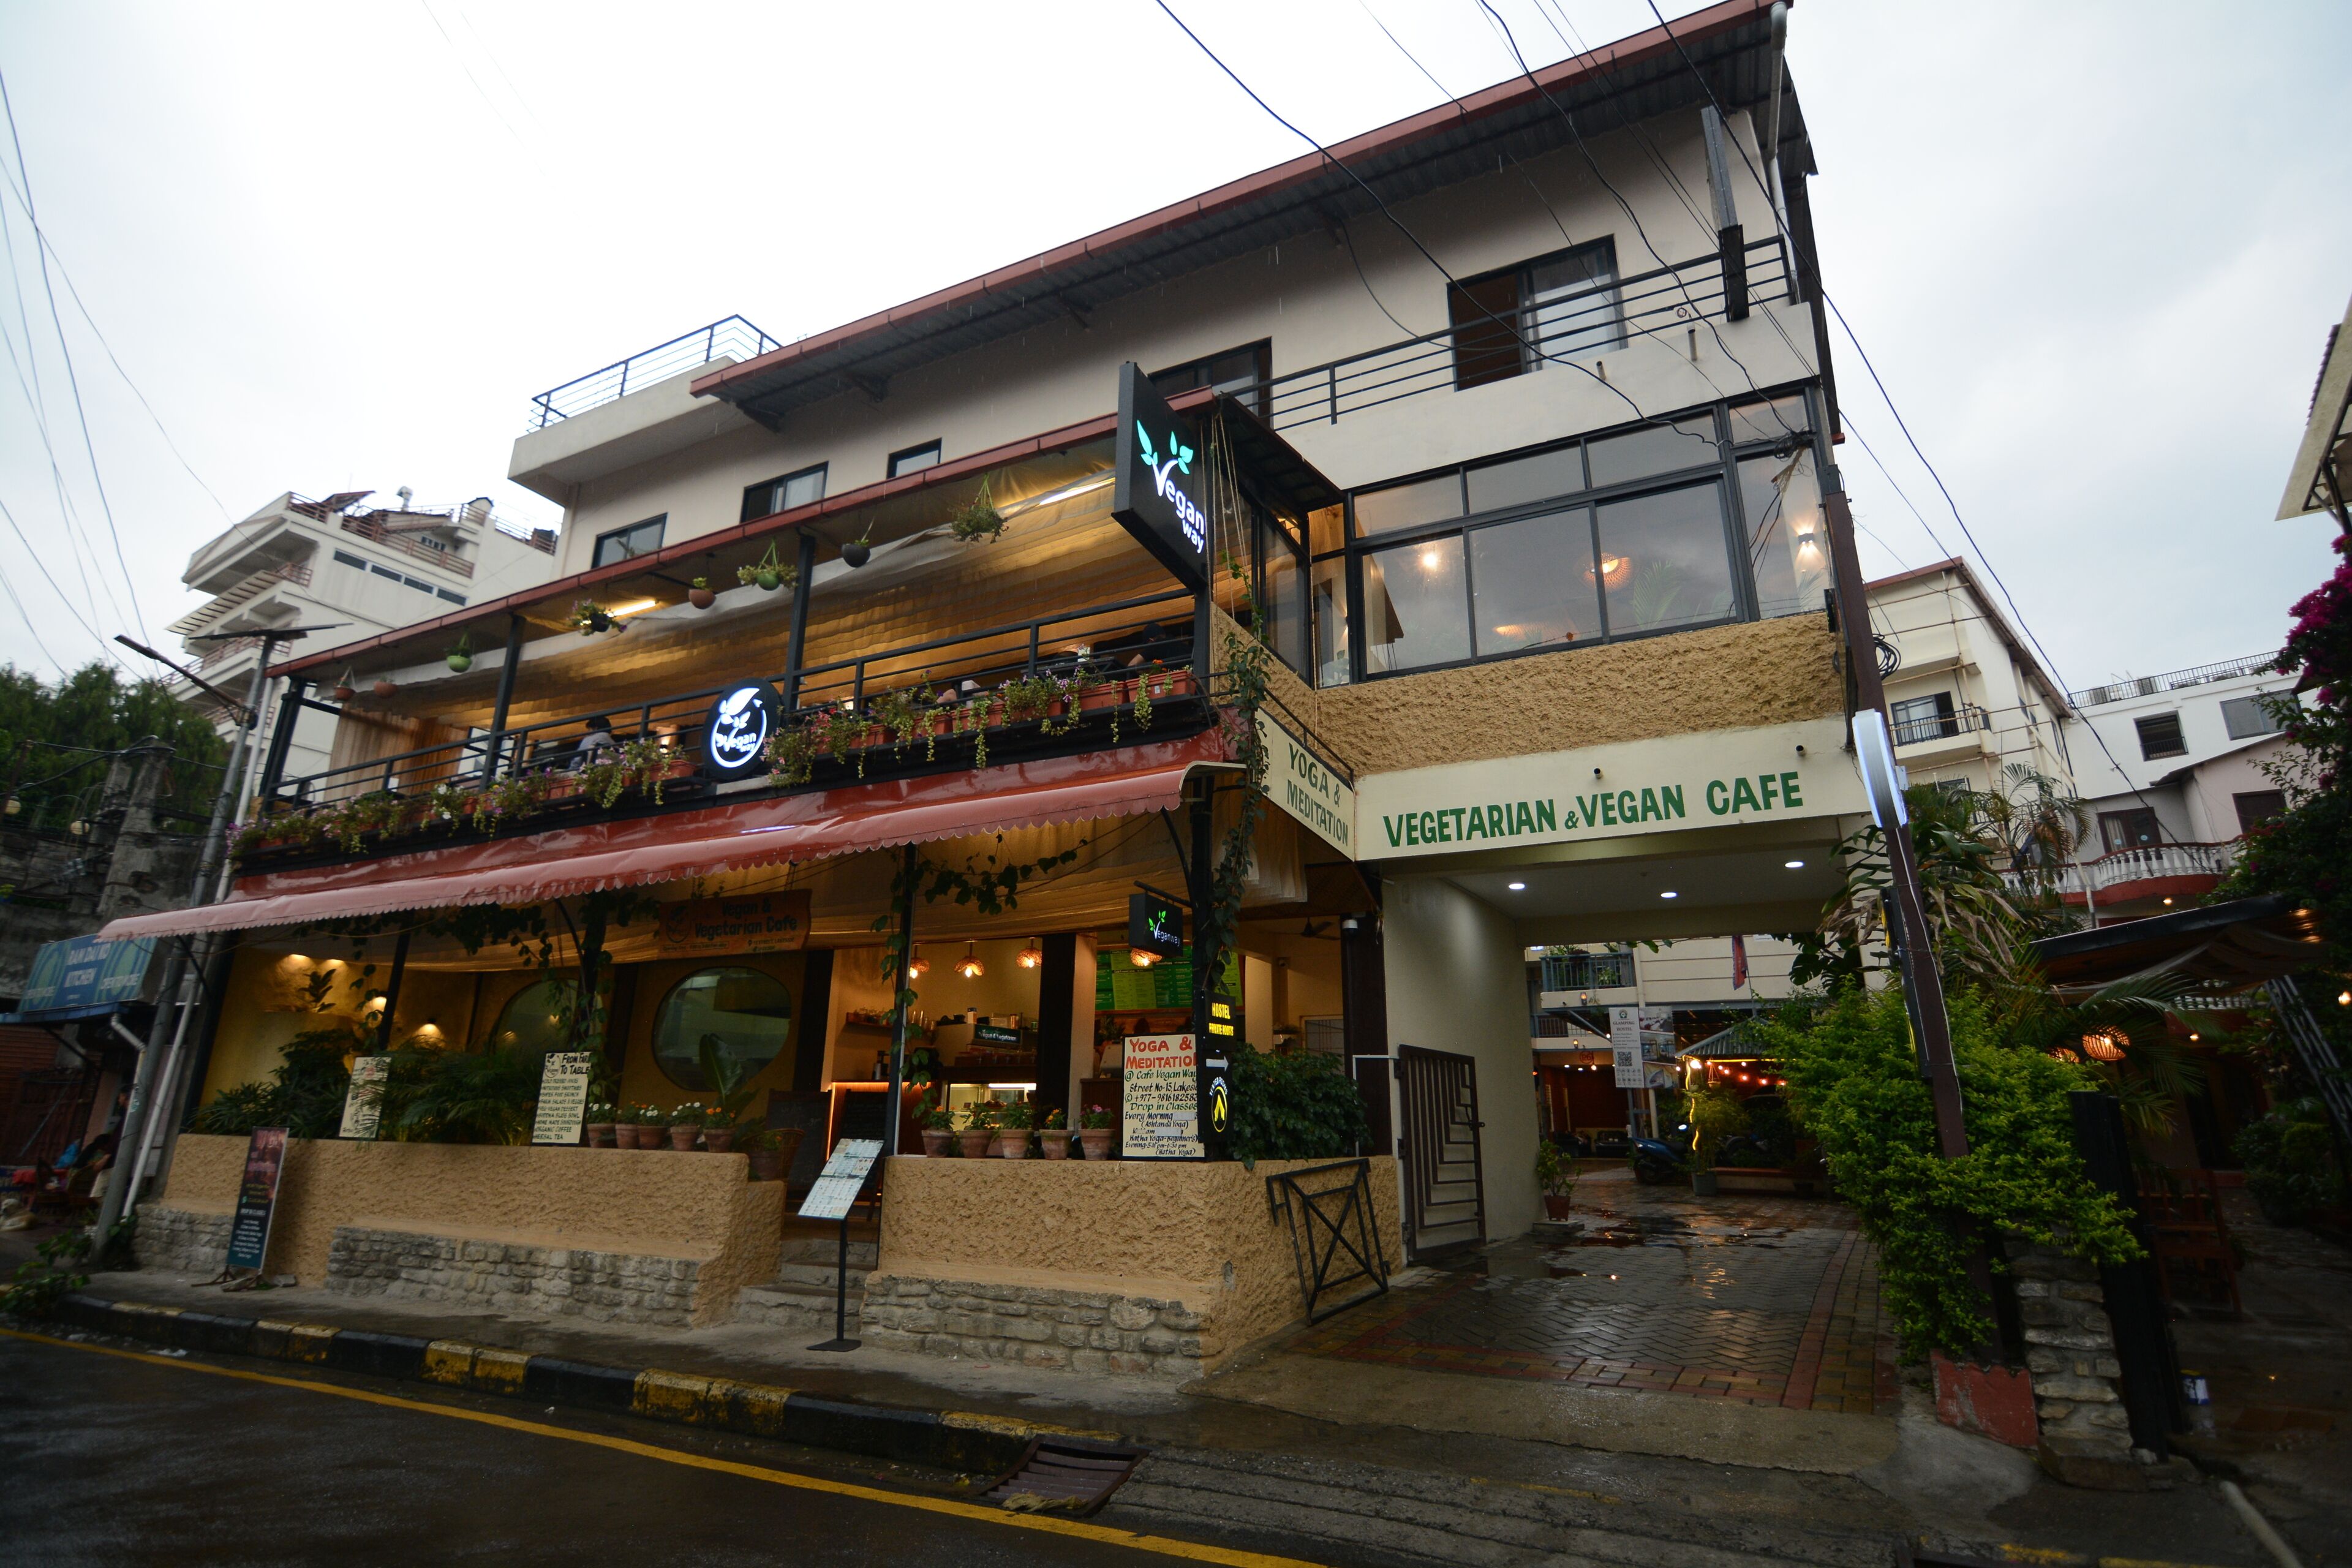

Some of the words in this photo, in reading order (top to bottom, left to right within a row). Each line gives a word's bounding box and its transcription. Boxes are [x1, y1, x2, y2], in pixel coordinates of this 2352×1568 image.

[1152, 459, 1204, 535] Vegan
[1182, 519, 1204, 554] way
[1289, 742, 1329, 799] YOGA
[1333, 783, 1341, 808] &
[1287, 779, 1349, 847] MEDITATION
[1383, 799, 1557, 847] VEGETARIAN
[1564, 810, 1580, 830] &
[1576, 784, 1686, 827] VEGAN
[1706, 771, 1803, 816] CAFE
[722, 902, 758, 918] Vegan
[695, 921, 763, 940] Vegetarian
[766, 915, 797, 933] Cafe
[1212, 1002, 1231, 1019] HOSTEL
[1208, 1022, 1222, 1035] PRIVATE
[1129, 1038, 1169, 1053] YOGA
[1179, 1036, 1193, 1051] &
[560, 1064, 568, 1075] TO
[570, 1065, 590, 1075] TABLE
[1125, 1070, 1134, 1082] @
[1136, 1069, 1154, 1080] Cafe
[1156, 1069, 1180, 1082] Vegan
[1129, 1082, 1153, 1093] Street
[1130, 1102, 1153, 1112] Drop
[1156, 1102, 1164, 1110] in
[1166, 1102, 1198, 1111] Classes
[1125, 1110, 1145, 1122] Every
[1146, 1111, 1173, 1121] Morning
[1178, 1148, 1196, 1157] Yoga)
